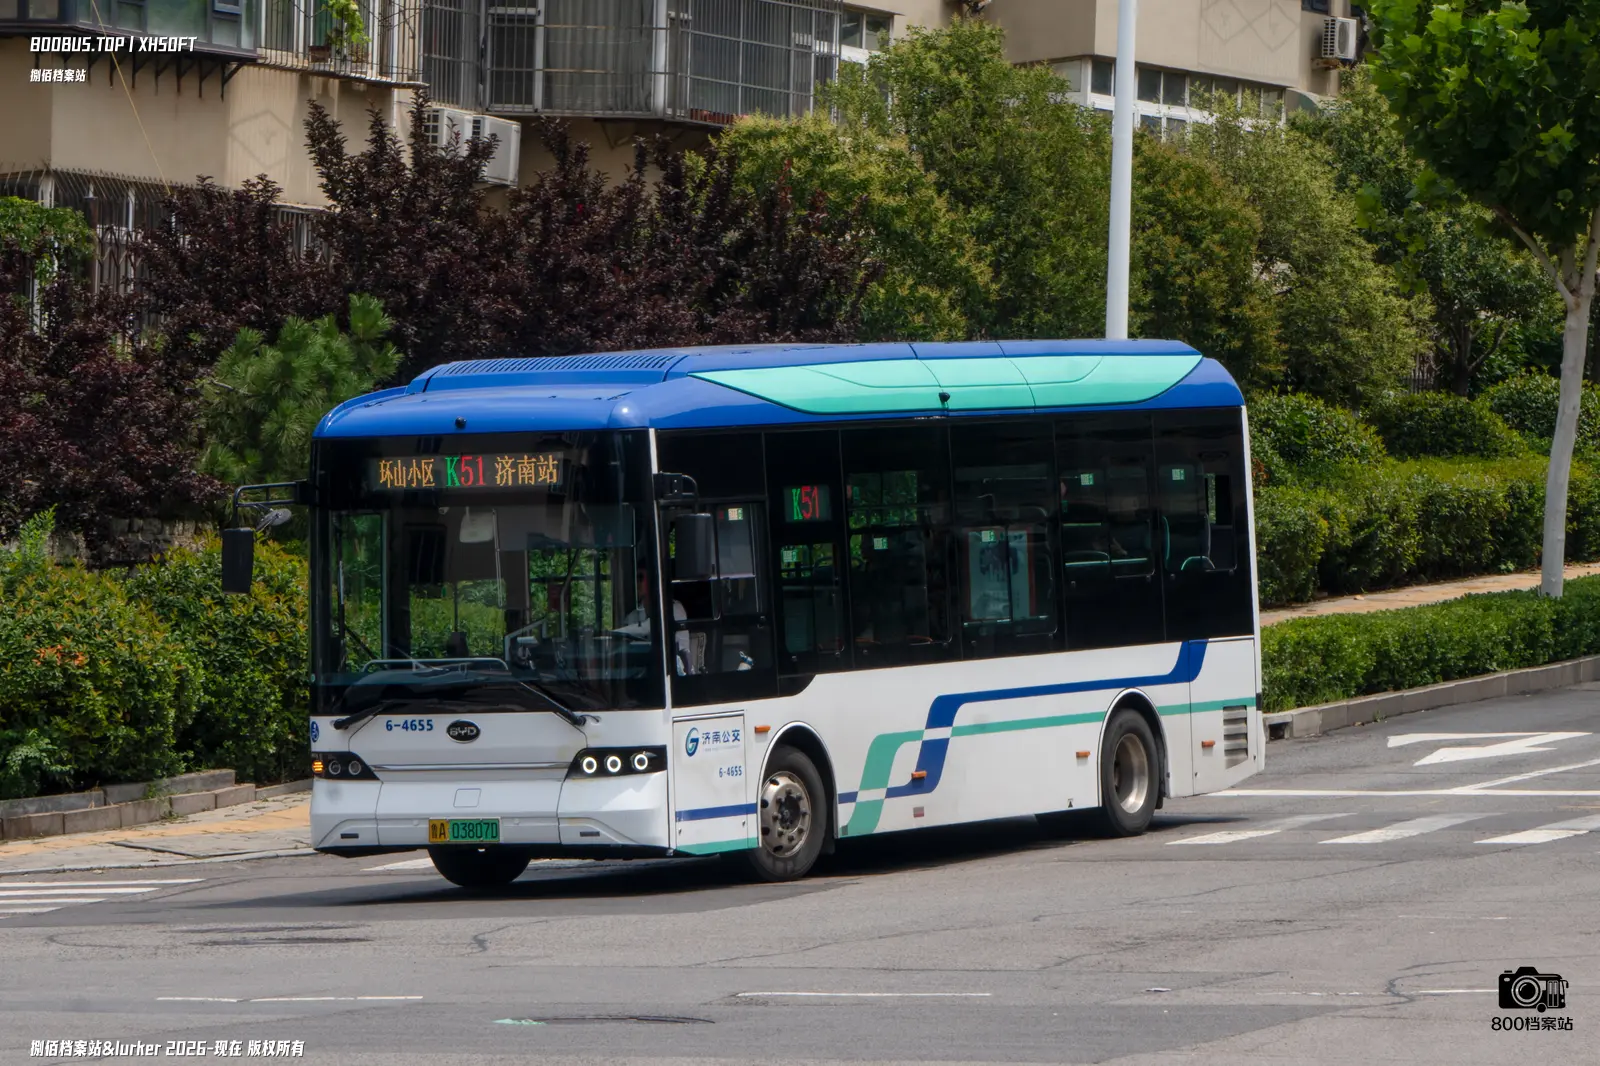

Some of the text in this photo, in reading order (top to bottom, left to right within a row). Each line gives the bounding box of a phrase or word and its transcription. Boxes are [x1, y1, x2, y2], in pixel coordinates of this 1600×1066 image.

[379, 454, 558, 488] 环山小区 K51 济南站
[791, 486, 819, 519] K51
[385, 719, 434, 732] 6-4655
[449, 727, 477, 736] BYD
[702, 729, 741, 745] 济南公交
[718, 765, 743, 778] 6-4655
